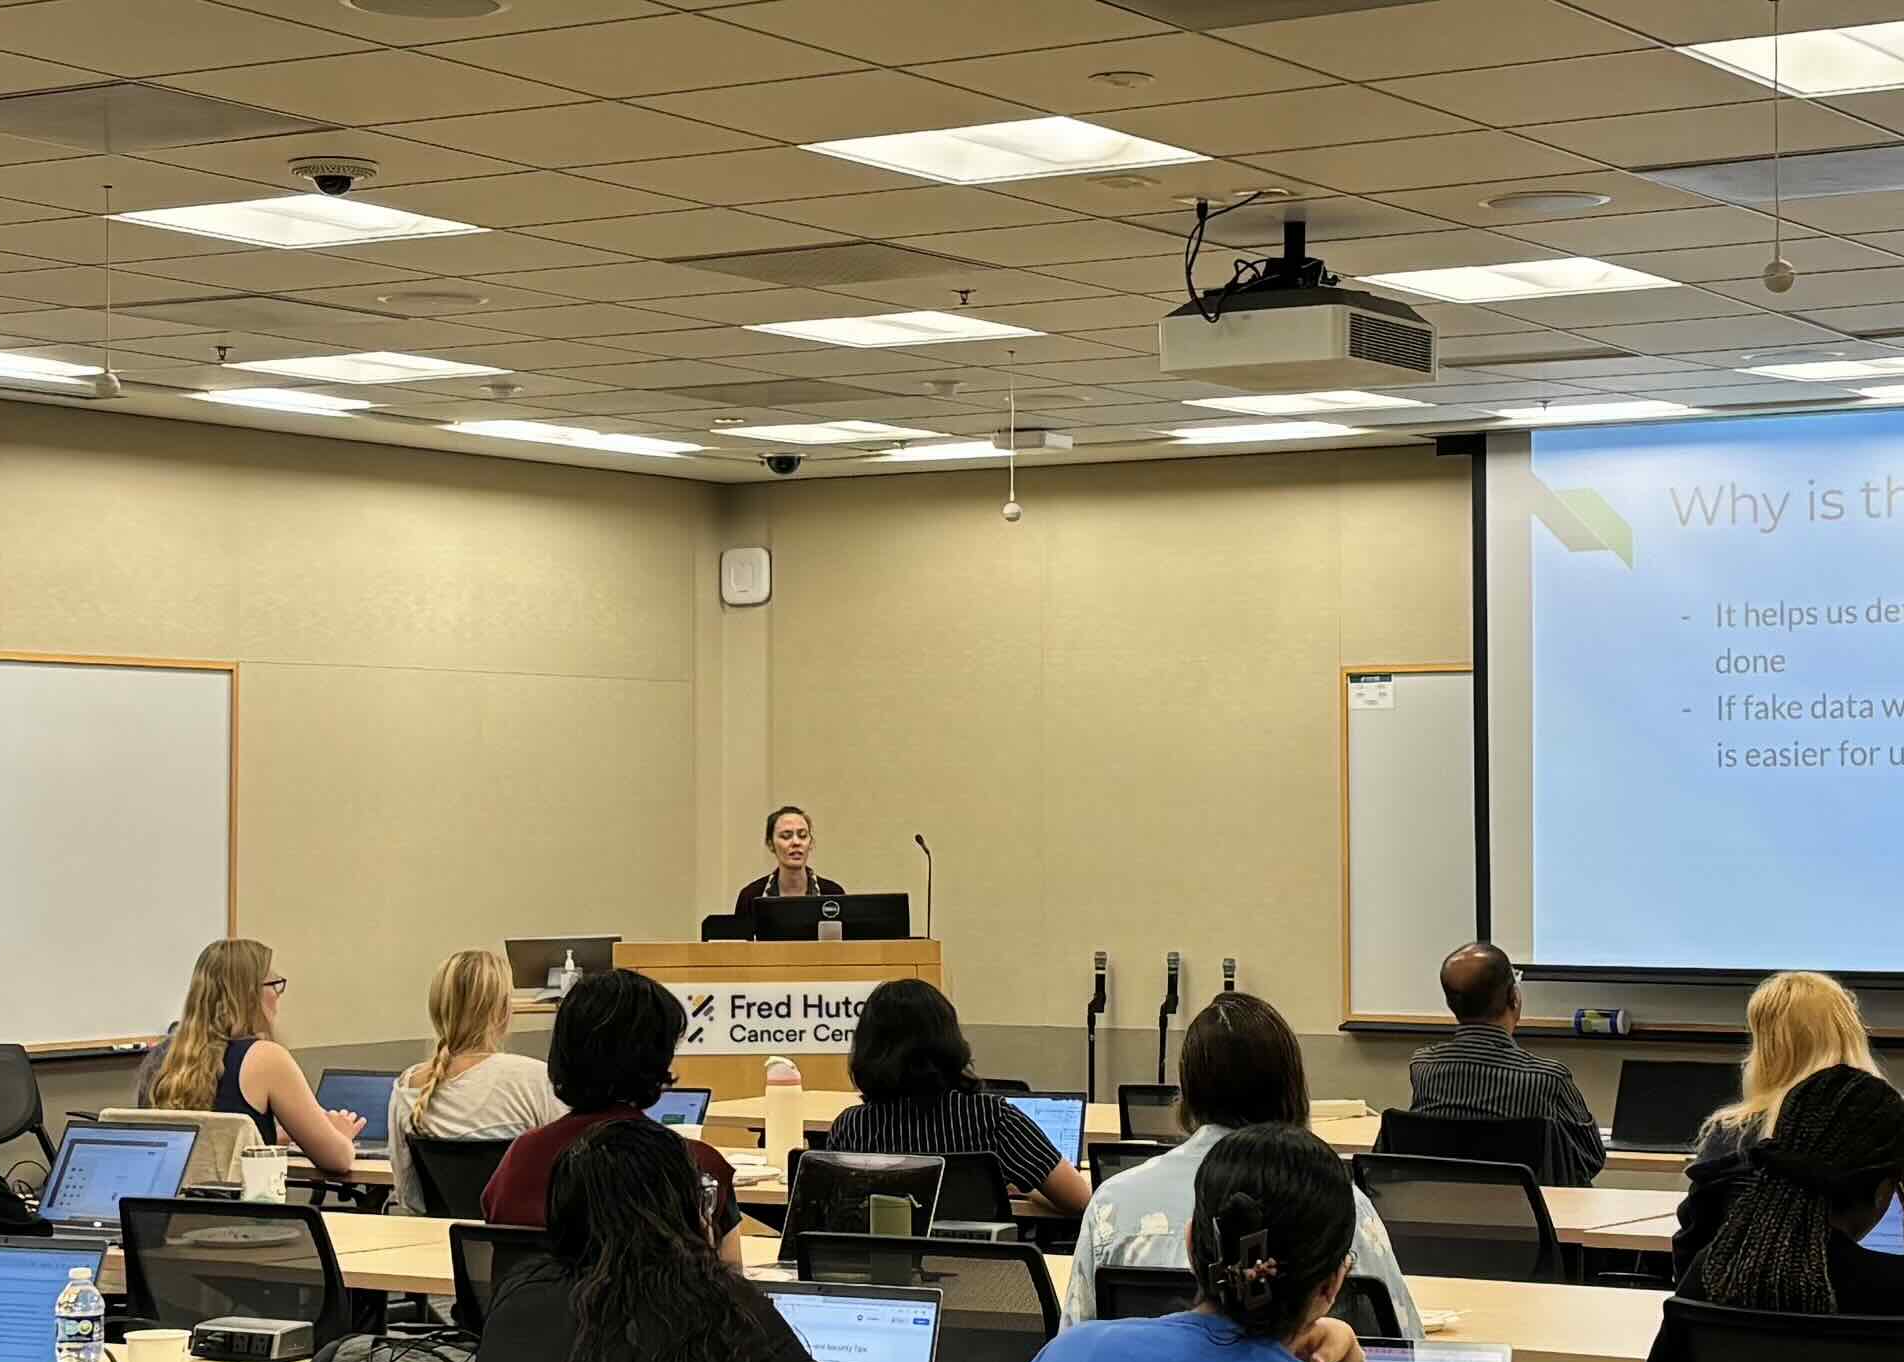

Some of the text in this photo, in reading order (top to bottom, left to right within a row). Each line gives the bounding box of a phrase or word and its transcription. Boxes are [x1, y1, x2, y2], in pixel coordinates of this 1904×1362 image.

[1670, 482, 1790, 533] Why
[1808, 478, 1846, 521] is
[1716, 603, 1736, 627] It
[1744, 601, 1819, 632] helps
[1827, 604, 1858, 624] us
[1715, 648, 1786, 674] done
[1717, 695, 1736, 720] If
[1744, 694, 1803, 720] fake
[1811, 693, 1873, 719] data
[1717, 743, 1737, 767] is
[1745, 741, 1831, 767] easier
[1839, 740, 1881, 766] for
[730, 994, 864, 1019] Fred Hutc
[729, 1024, 856, 1043] Cancer Cen
